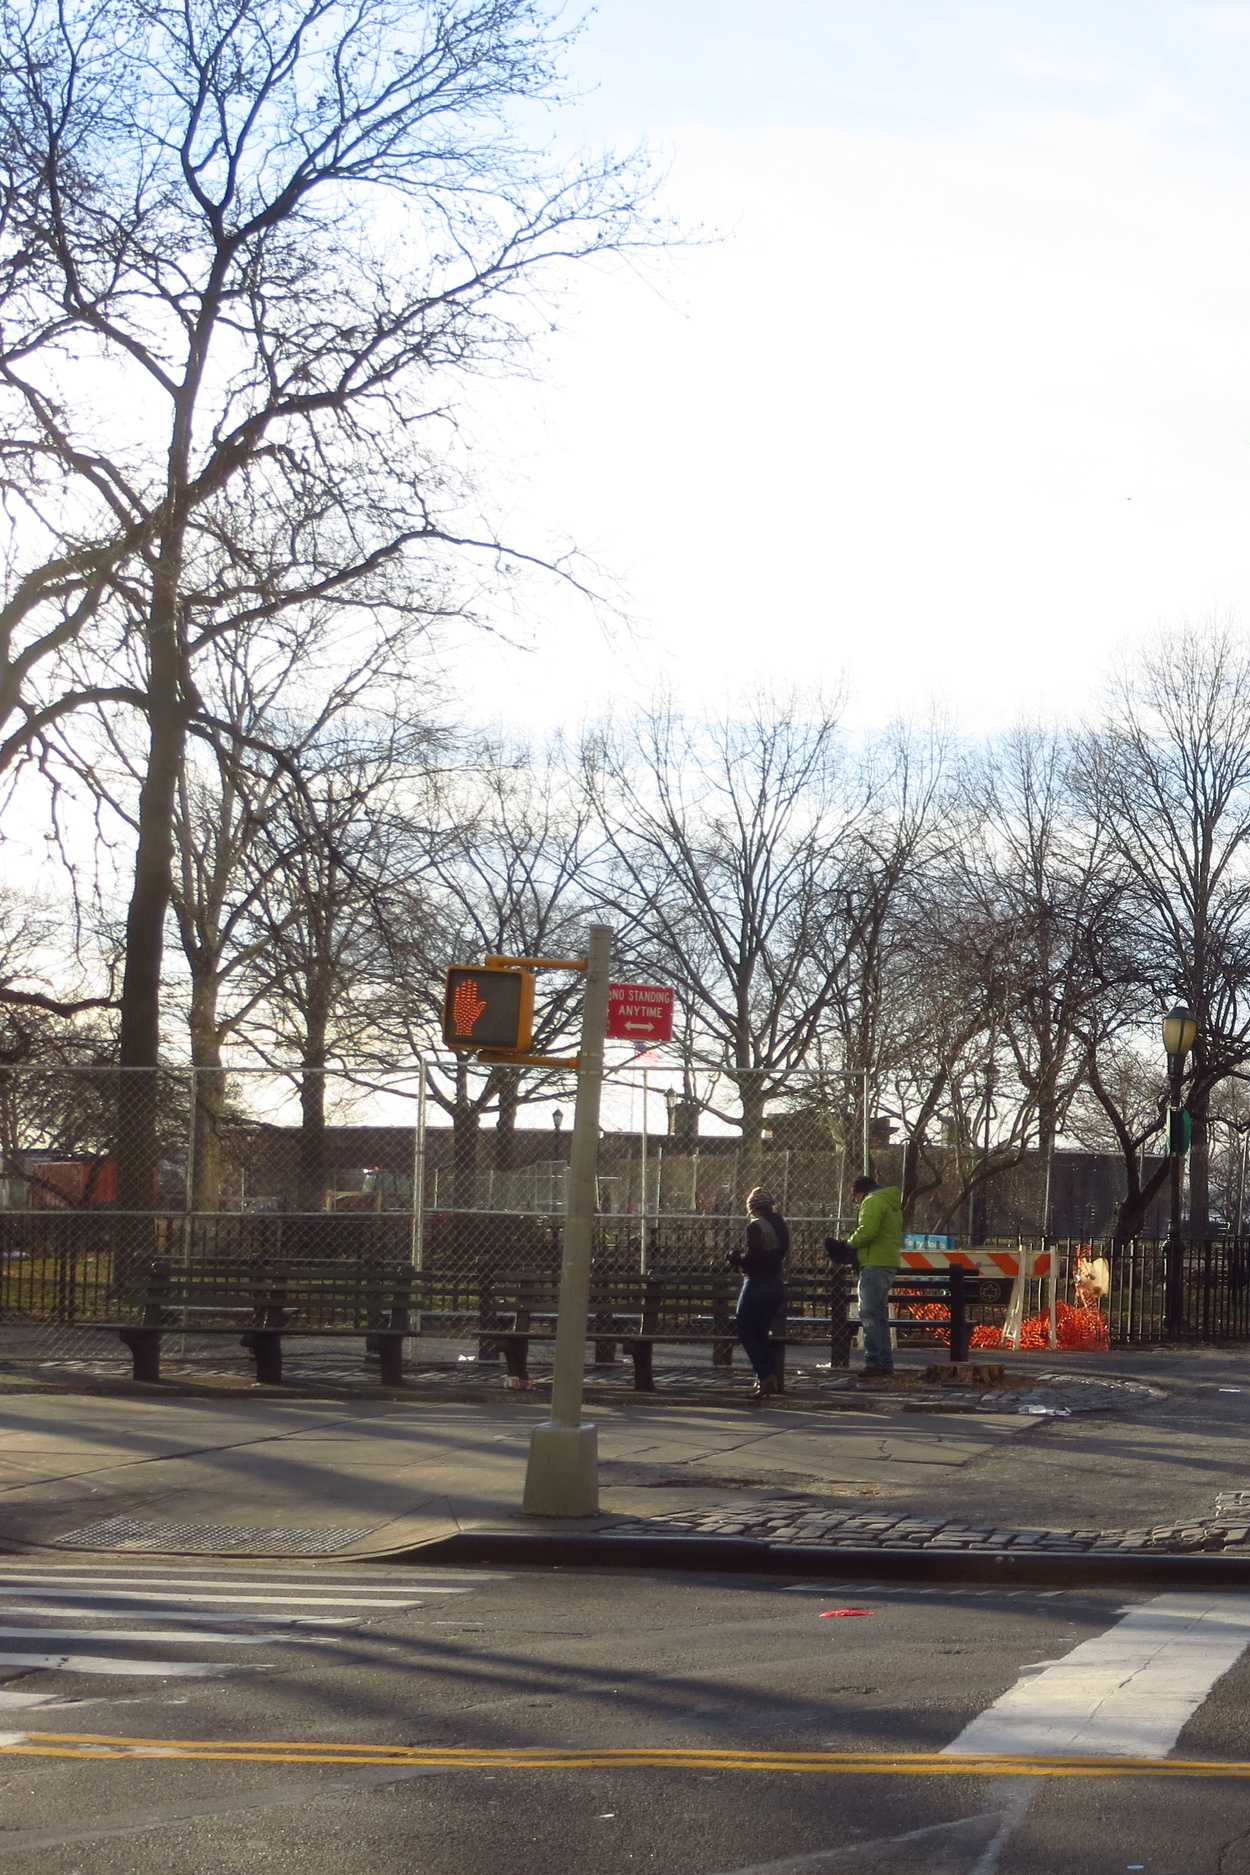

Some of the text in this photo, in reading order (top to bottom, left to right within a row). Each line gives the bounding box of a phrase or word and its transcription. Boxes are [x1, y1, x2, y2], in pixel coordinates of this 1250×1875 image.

[612, 989, 670, 1003] NO STANDING
[618, 1005, 663, 1018] ANYTIME
[904, 1238, 924, 1249] Fery
